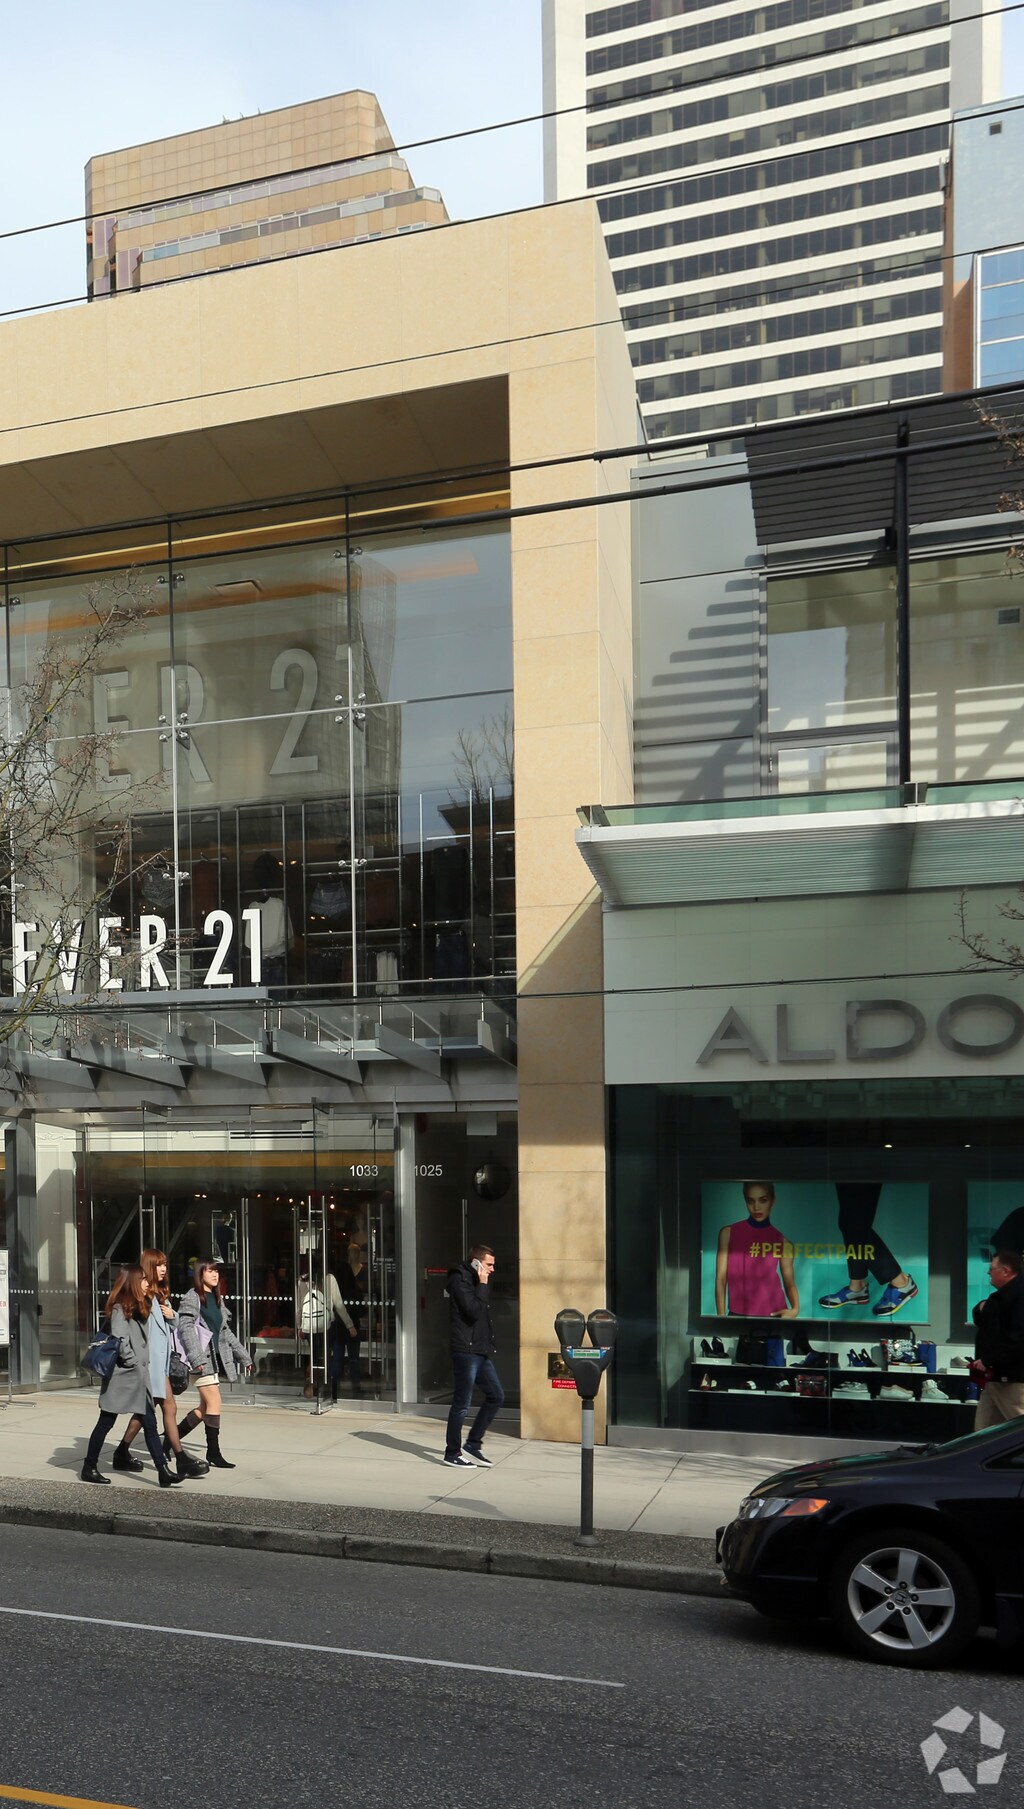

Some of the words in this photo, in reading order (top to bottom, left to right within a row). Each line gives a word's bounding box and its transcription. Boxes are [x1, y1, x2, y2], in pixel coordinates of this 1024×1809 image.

[203, 907, 262, 986] 21
[696, 993, 1024, 1064] ALDO
[349, 1164, 379, 1177] 1033
[414, 1164, 443, 1177] 1025
[749, 1242, 875, 1261] #PERFECTPAIR
